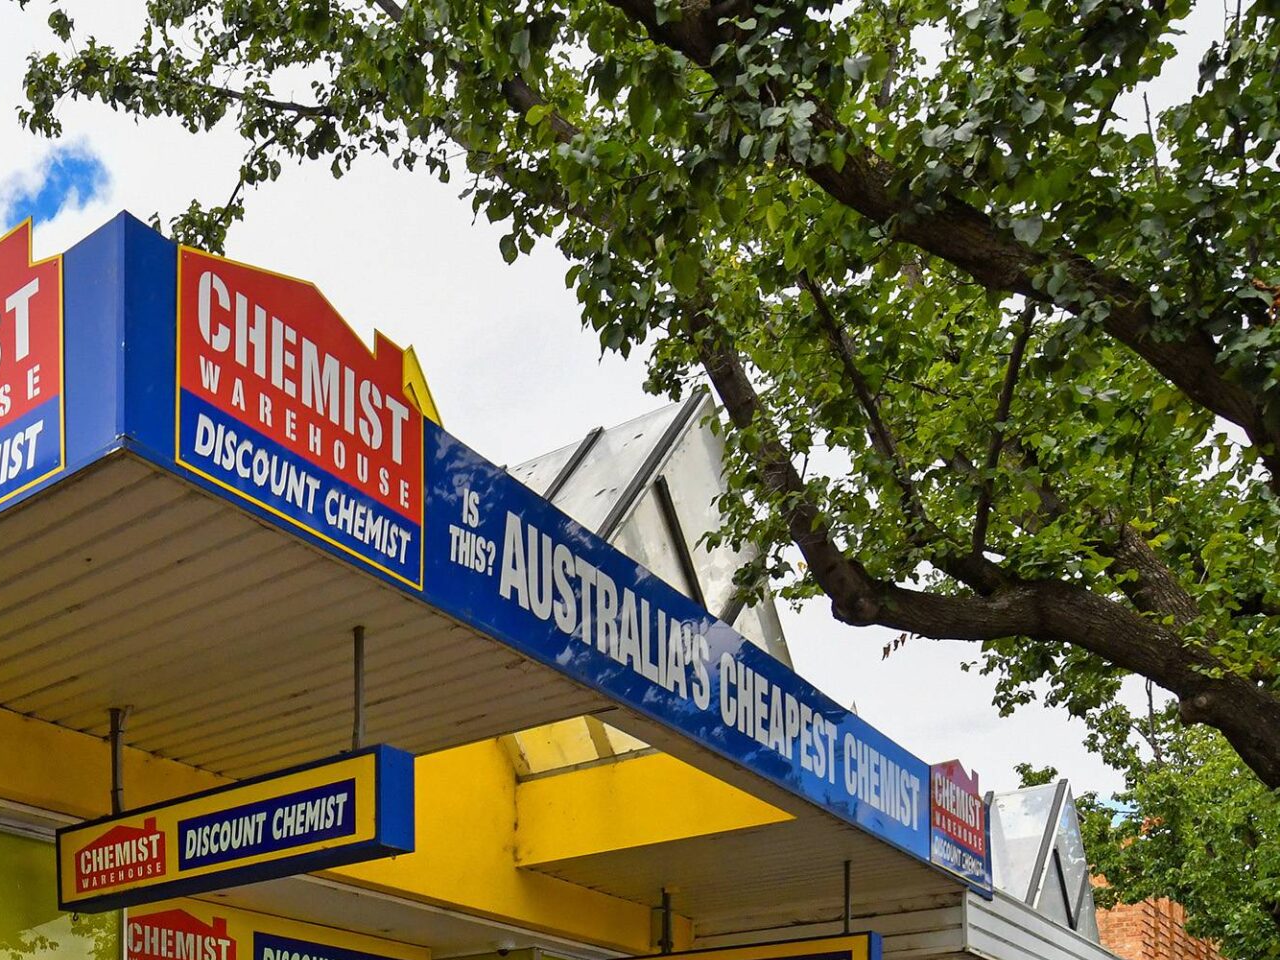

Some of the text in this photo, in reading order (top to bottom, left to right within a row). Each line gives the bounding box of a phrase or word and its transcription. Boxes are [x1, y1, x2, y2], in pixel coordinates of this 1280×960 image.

[197, 270, 409, 465] CHEMIST
[199, 354, 410, 509] WAREHOUSE
[195, 412, 412, 565] DISCOUNT CHEMIST
[462, 489, 480, 528] IS
[449, 524, 496, 577] THIS?
[499, 510, 920, 832] AUSTRALIA'S CHEAPEST CHEMIST
[185, 792, 348, 860] DISCOUNT CHEMIST
[934, 772, 981, 830] CHEMIST
[80, 833, 160, 874] CHEMIST
[935, 811, 982, 850] WAREHOUSE
[82, 862, 162, 889] WAREHOUSE
